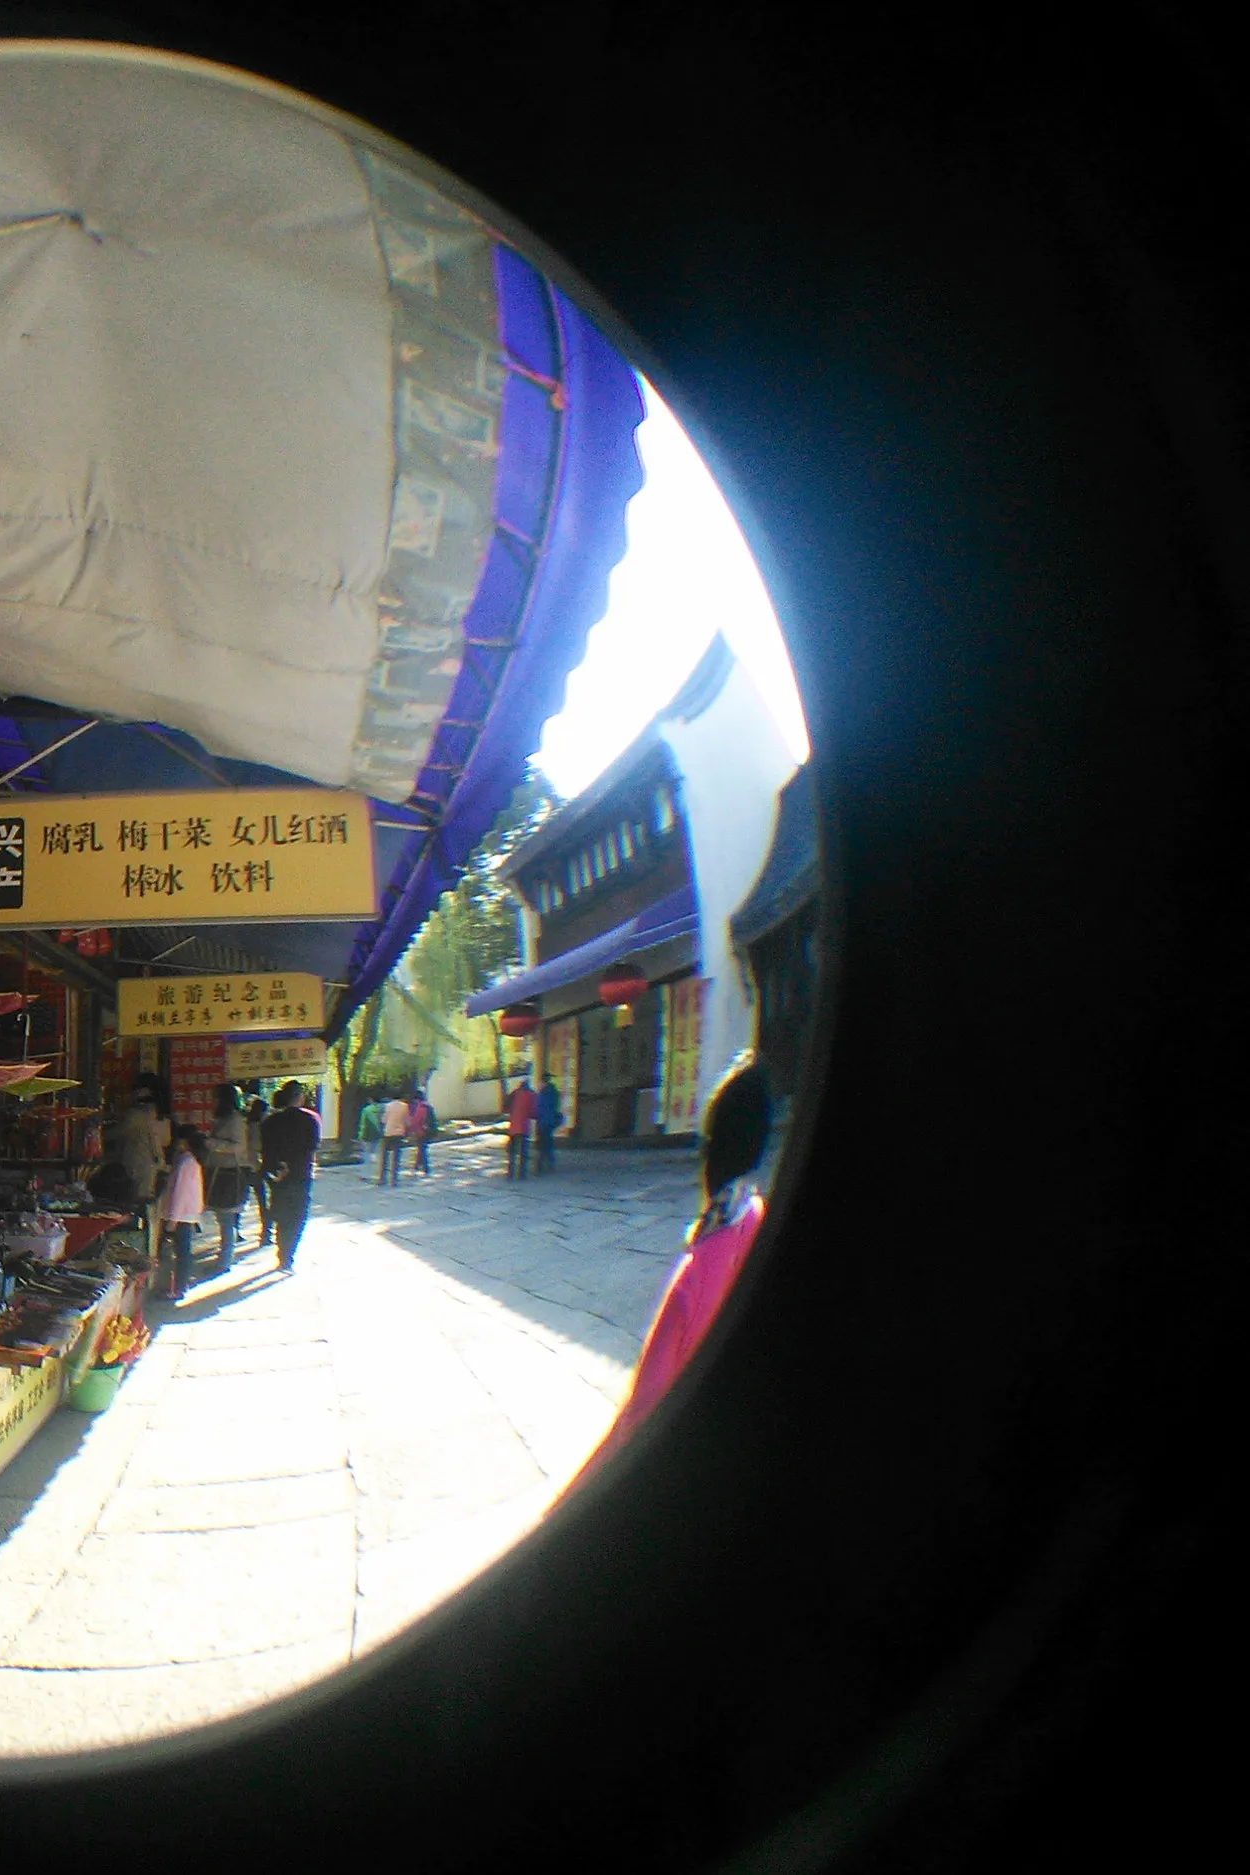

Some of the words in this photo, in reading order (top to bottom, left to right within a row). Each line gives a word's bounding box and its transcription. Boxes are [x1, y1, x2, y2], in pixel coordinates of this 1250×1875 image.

[40, 820, 104, 855] 腐乳
[116, 816, 212, 853] 梅干菜
[227, 811, 349, 848] 女儿红酒
[121, 863, 185, 899] 棒冰
[210, 859, 275, 895] 饮料
[156, 980, 289, 1007] 旅游纪念品
